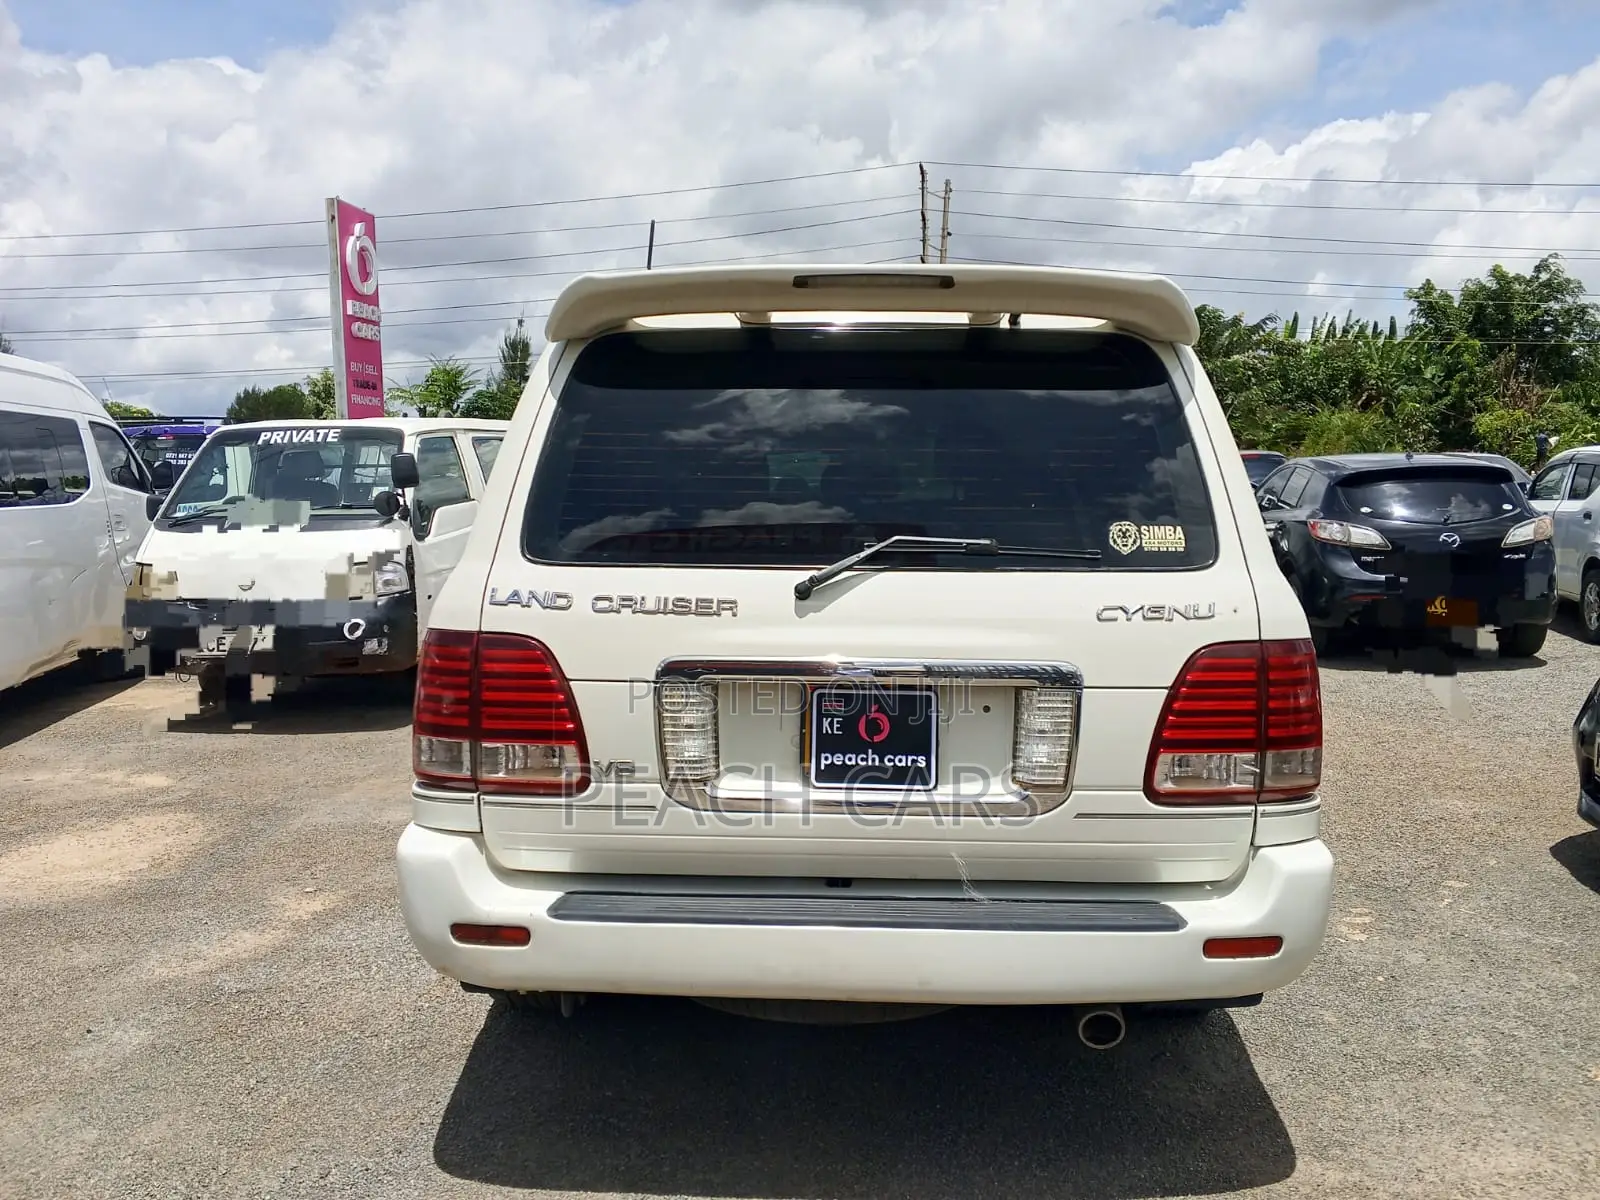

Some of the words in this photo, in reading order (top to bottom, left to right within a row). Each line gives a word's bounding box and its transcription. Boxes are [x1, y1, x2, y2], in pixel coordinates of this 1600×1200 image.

[351, 322, 380, 341] CARS
[257, 428, 341, 445] PRIVATE
[1140, 525, 1185, 540] SIMBA
[488, 587, 574, 611] LAND
[591, 594, 739, 617] CRUISER
[1096, 602, 1216, 622] CYGNU
[822, 717, 843, 735] KE
[820, 748, 880, 771] peach
[883, 754, 927, 768] cars
